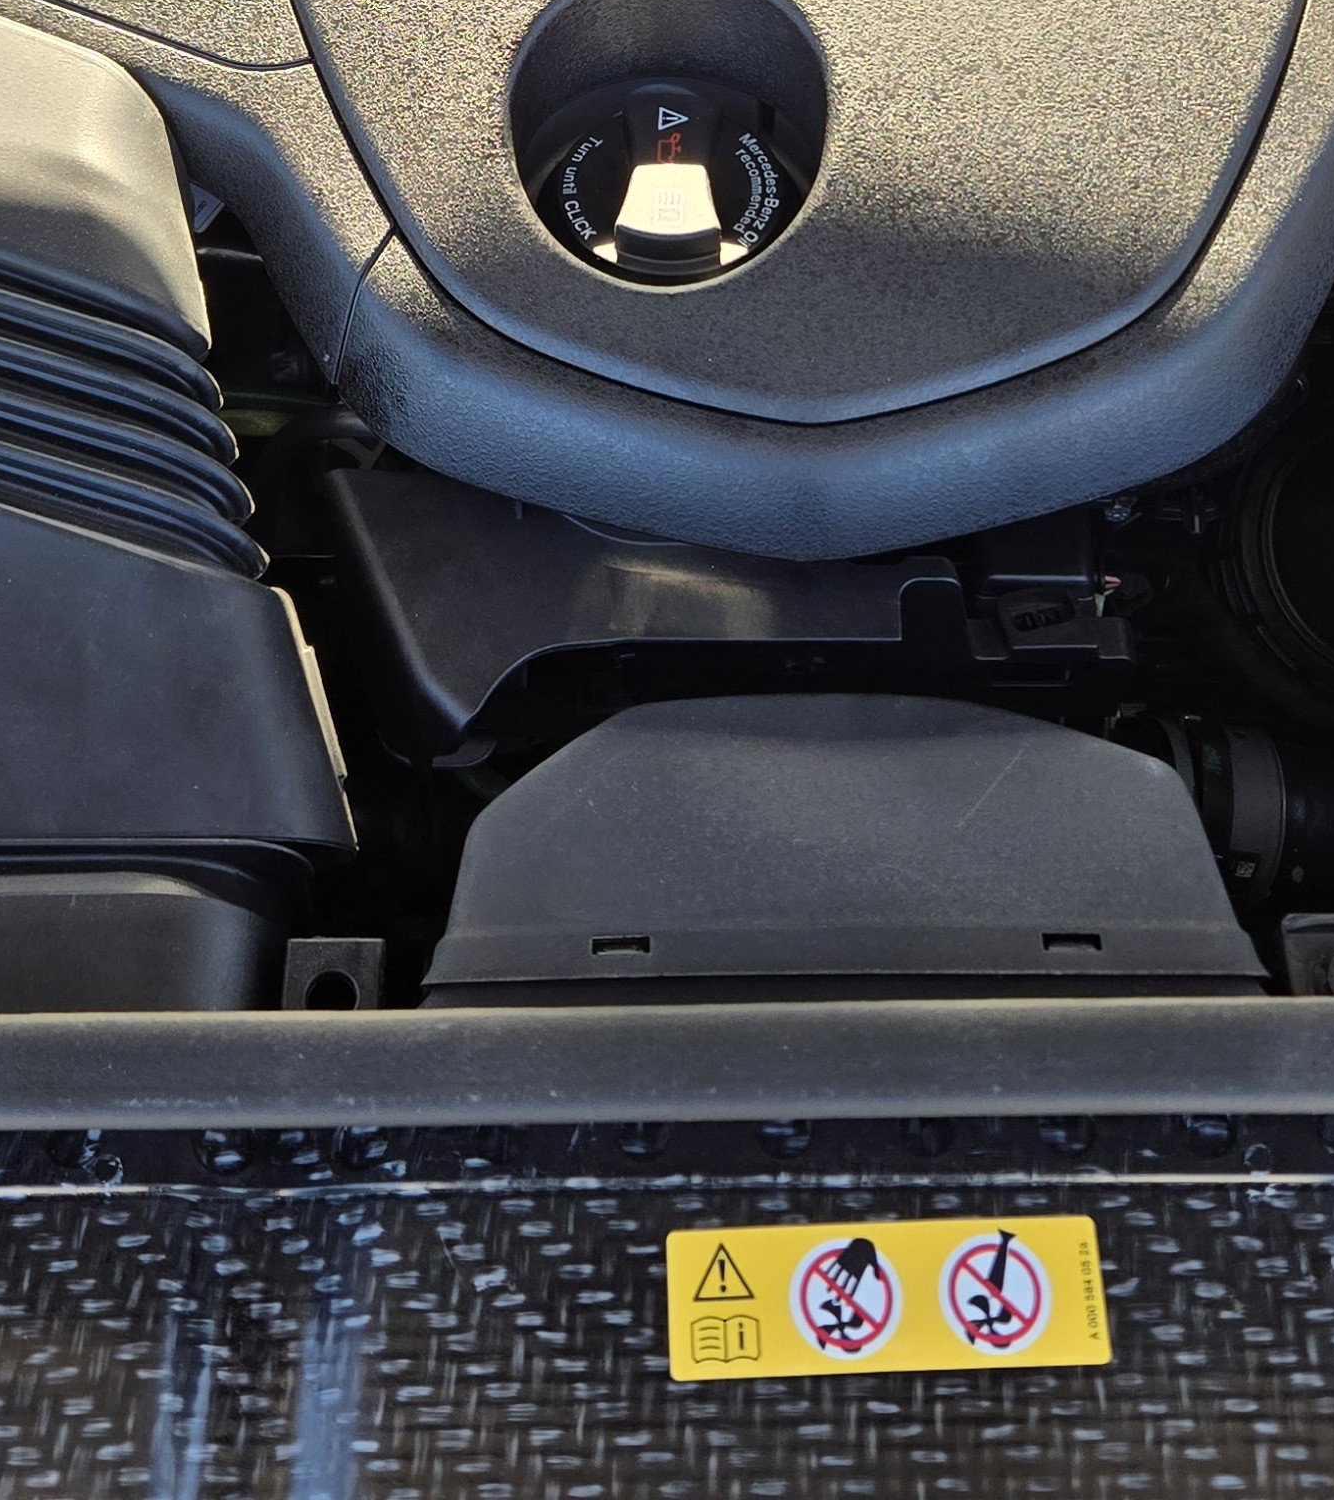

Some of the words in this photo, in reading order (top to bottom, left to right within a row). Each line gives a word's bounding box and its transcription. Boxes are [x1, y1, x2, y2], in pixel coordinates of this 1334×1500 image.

[571, 137, 603, 162] Turn
[562, 167, 578, 195] until
[732, 148, 762, 234] recommended
[738, 132, 780, 231] Mercedes-Benz
[564, 200, 597, 240] CLICK
